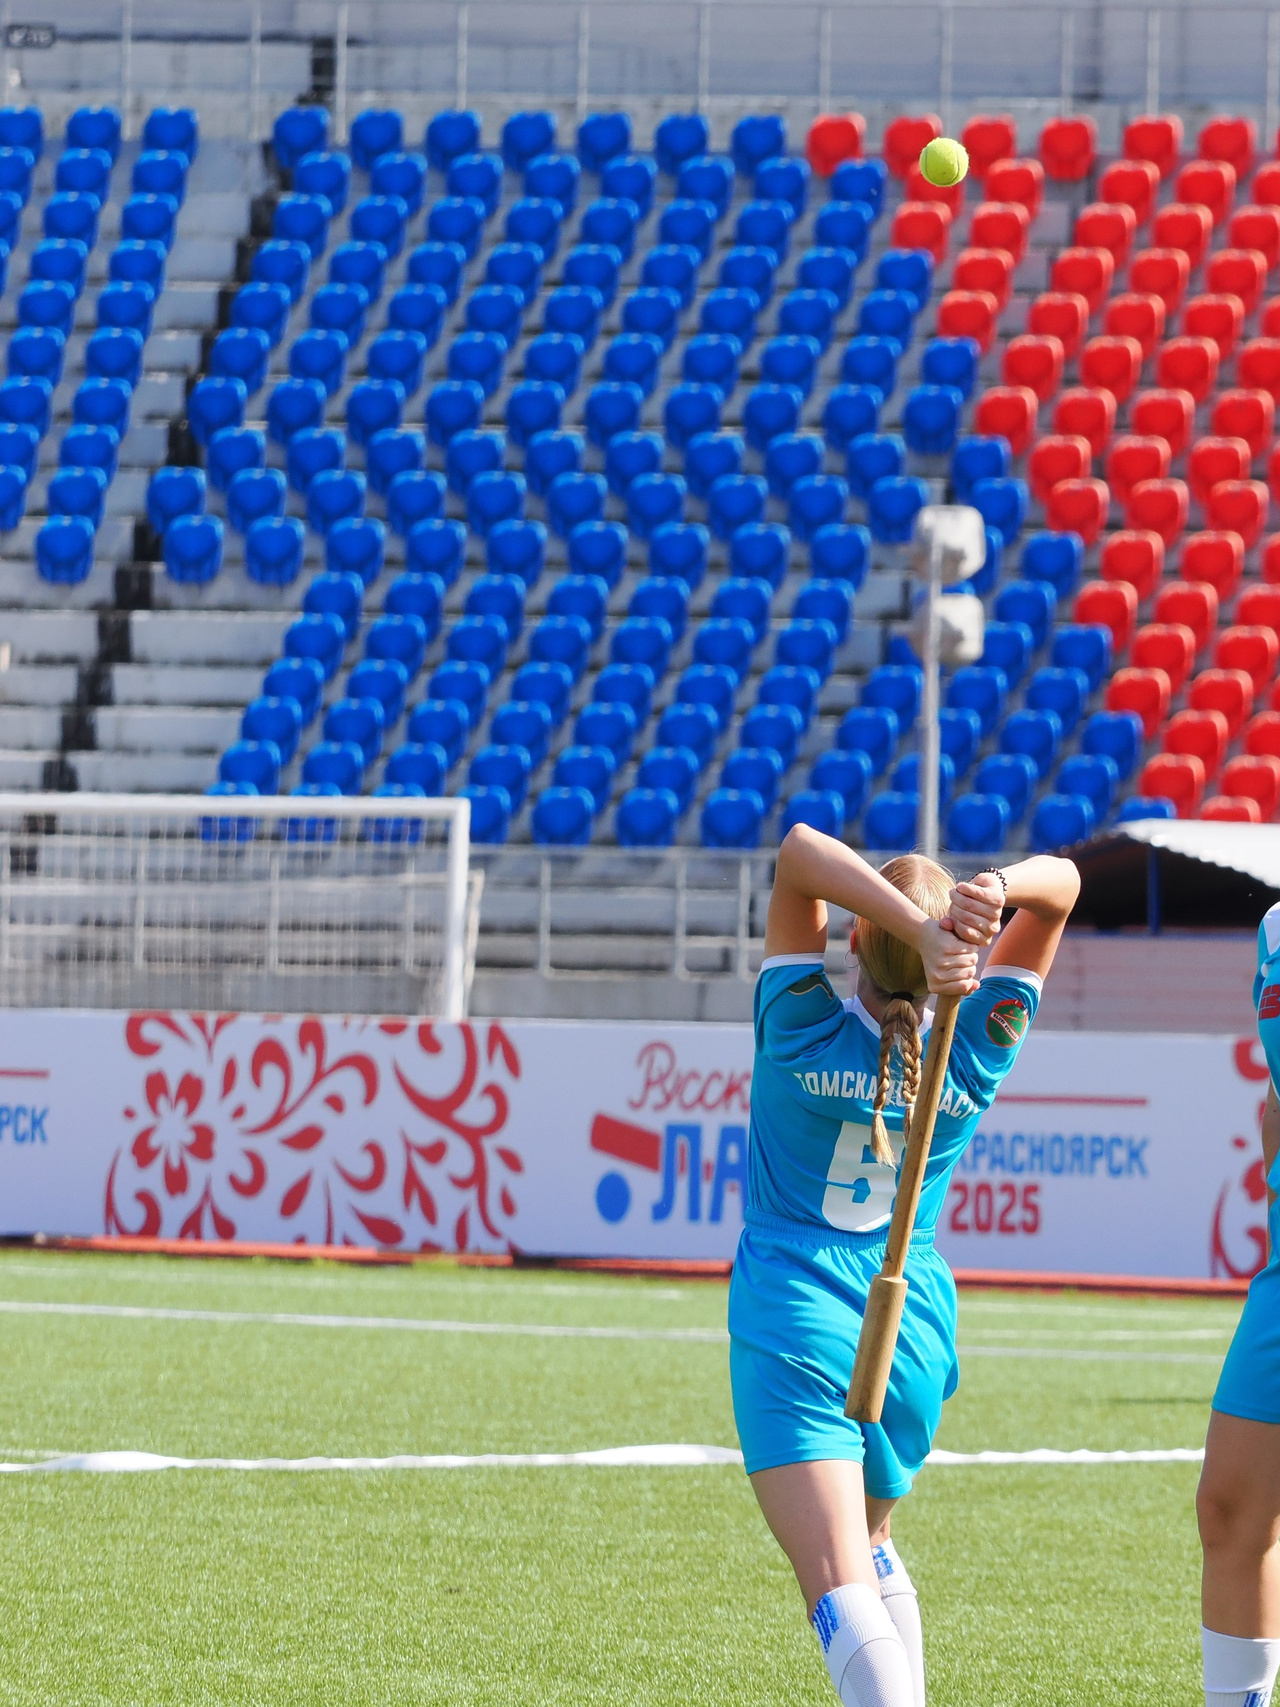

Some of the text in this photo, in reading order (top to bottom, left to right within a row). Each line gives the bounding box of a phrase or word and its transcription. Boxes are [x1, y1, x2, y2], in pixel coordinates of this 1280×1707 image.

[628, 1040, 751, 1113] Русск
[822, 1120, 906, 1232] 5
[950, 1180, 1040, 1236] 2025
